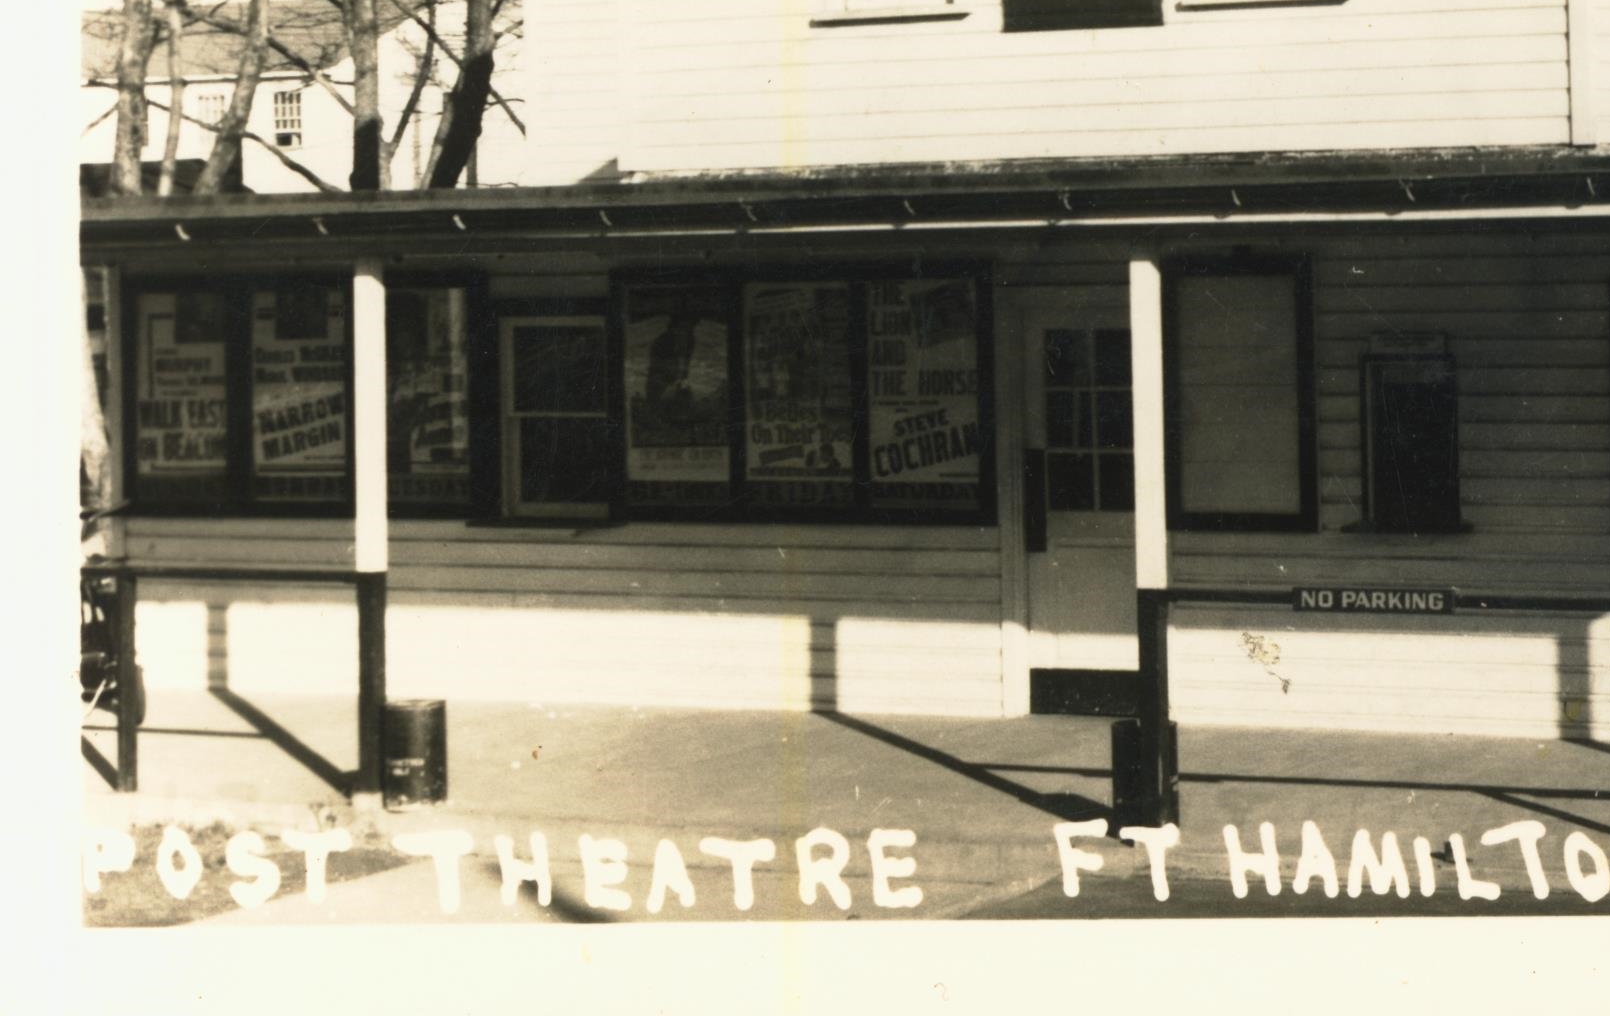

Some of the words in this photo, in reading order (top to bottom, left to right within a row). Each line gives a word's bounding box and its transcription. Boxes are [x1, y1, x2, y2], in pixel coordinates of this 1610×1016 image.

[872, 371, 906, 395] THE
[918, 370, 978, 395] HORSE
[257, 392, 344, 434] NARROW
[894, 407, 949, 437] STEVE
[263, 421, 341, 460] MARGIN
[874, 422, 981, 477] COCHRAN
[387, 480, 469, 497] UESDAY
[1301, 590, 1334, 608] NO
[1341, 591, 1444, 610] PARKING
